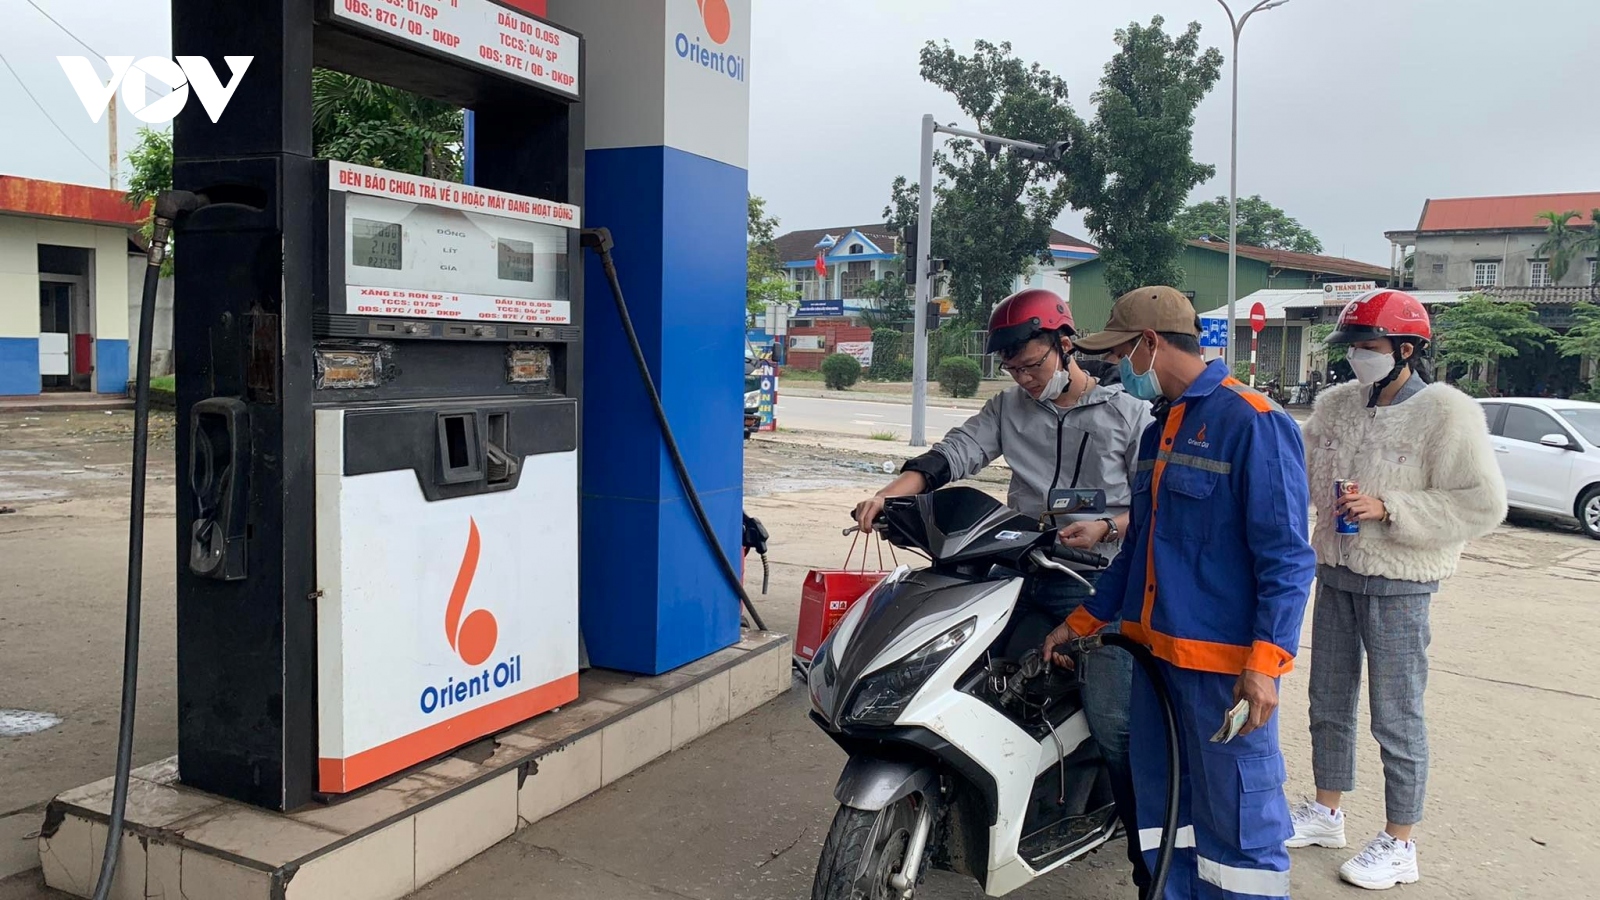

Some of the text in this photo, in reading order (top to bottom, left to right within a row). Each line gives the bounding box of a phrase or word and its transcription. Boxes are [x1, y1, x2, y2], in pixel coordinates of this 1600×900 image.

[376, 8, 397, 26] 87C
[500, 33, 526, 52] TCCS:
[546, 50, 558, 62] SP
[520, 21, 533, 36] DO
[536, 28, 560, 46] 0.05S
[505, 54, 522, 70] 87E
[675, 32, 744, 82] Orient Oil
[339, 168, 362, 187] ĐÈN
[365, 174, 386, 191] BÁO
[389, 179, 416, 196] CHƯA
[419, 183, 437, 199] TRẢ
[462, 191, 485, 209] HOẶC
[488, 195, 506, 210] MÁY
[508, 199, 530, 213] ĐANG
[532, 204, 551, 218] HOẠT
[420, 655, 521, 714] Orient Oil
